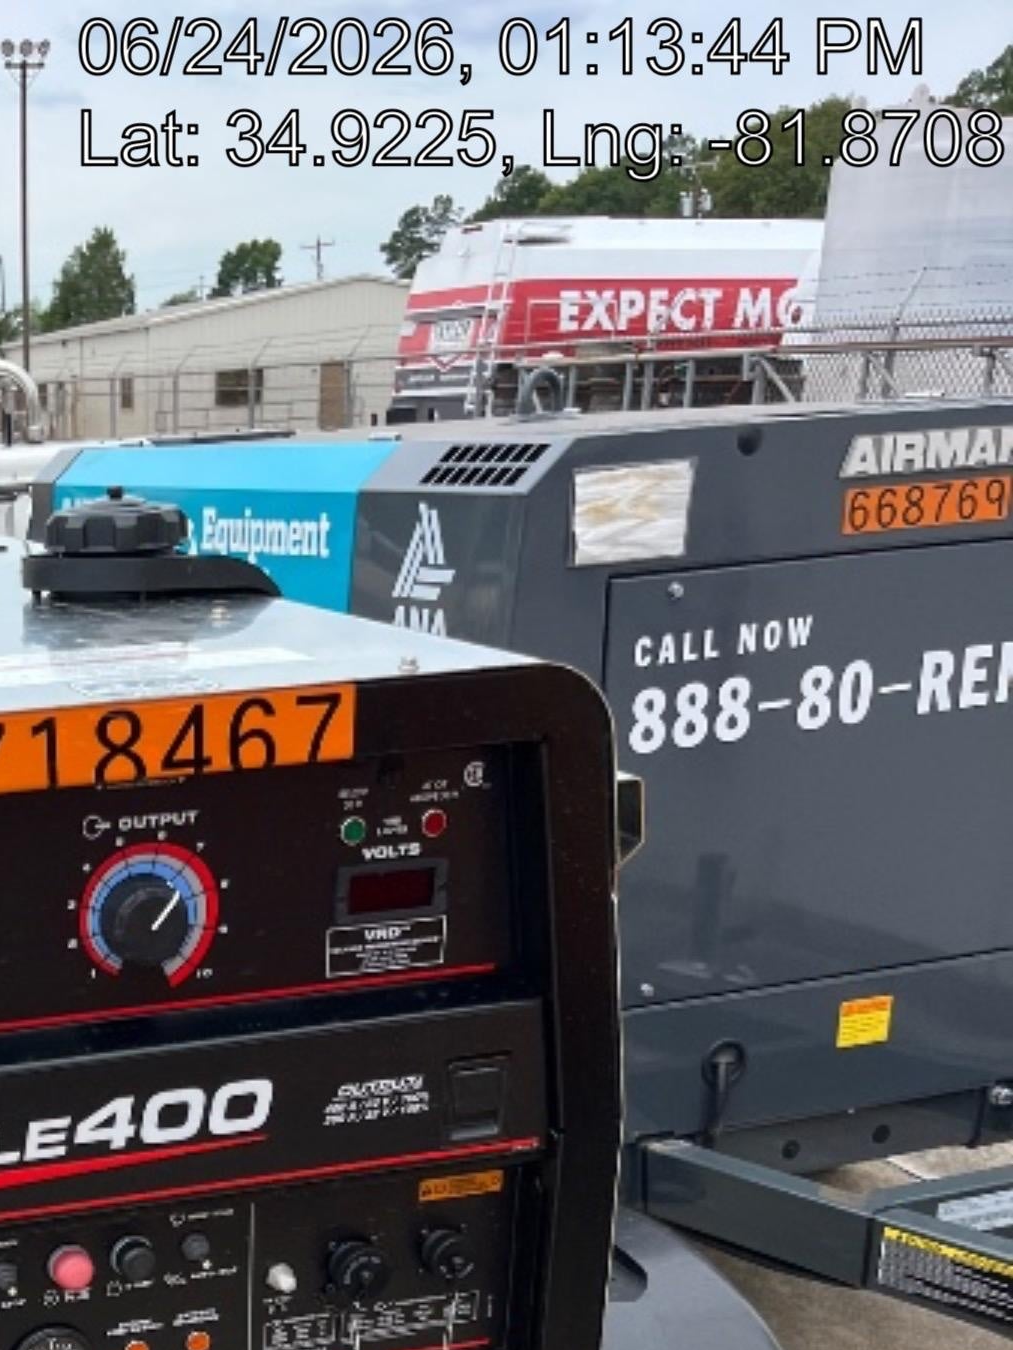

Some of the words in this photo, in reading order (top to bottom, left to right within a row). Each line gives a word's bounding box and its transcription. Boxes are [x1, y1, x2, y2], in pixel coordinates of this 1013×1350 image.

[558, 287, 724, 332] EXPECT
[848, 478, 1007, 532] 668769
[201, 506, 330, 565] Equipment
[633, 628, 720, 668] CALL
[737, 615, 814, 656] NOW
[118, 809, 200, 832] OUTPUT
[361, 842, 422, 862] VOLTS
